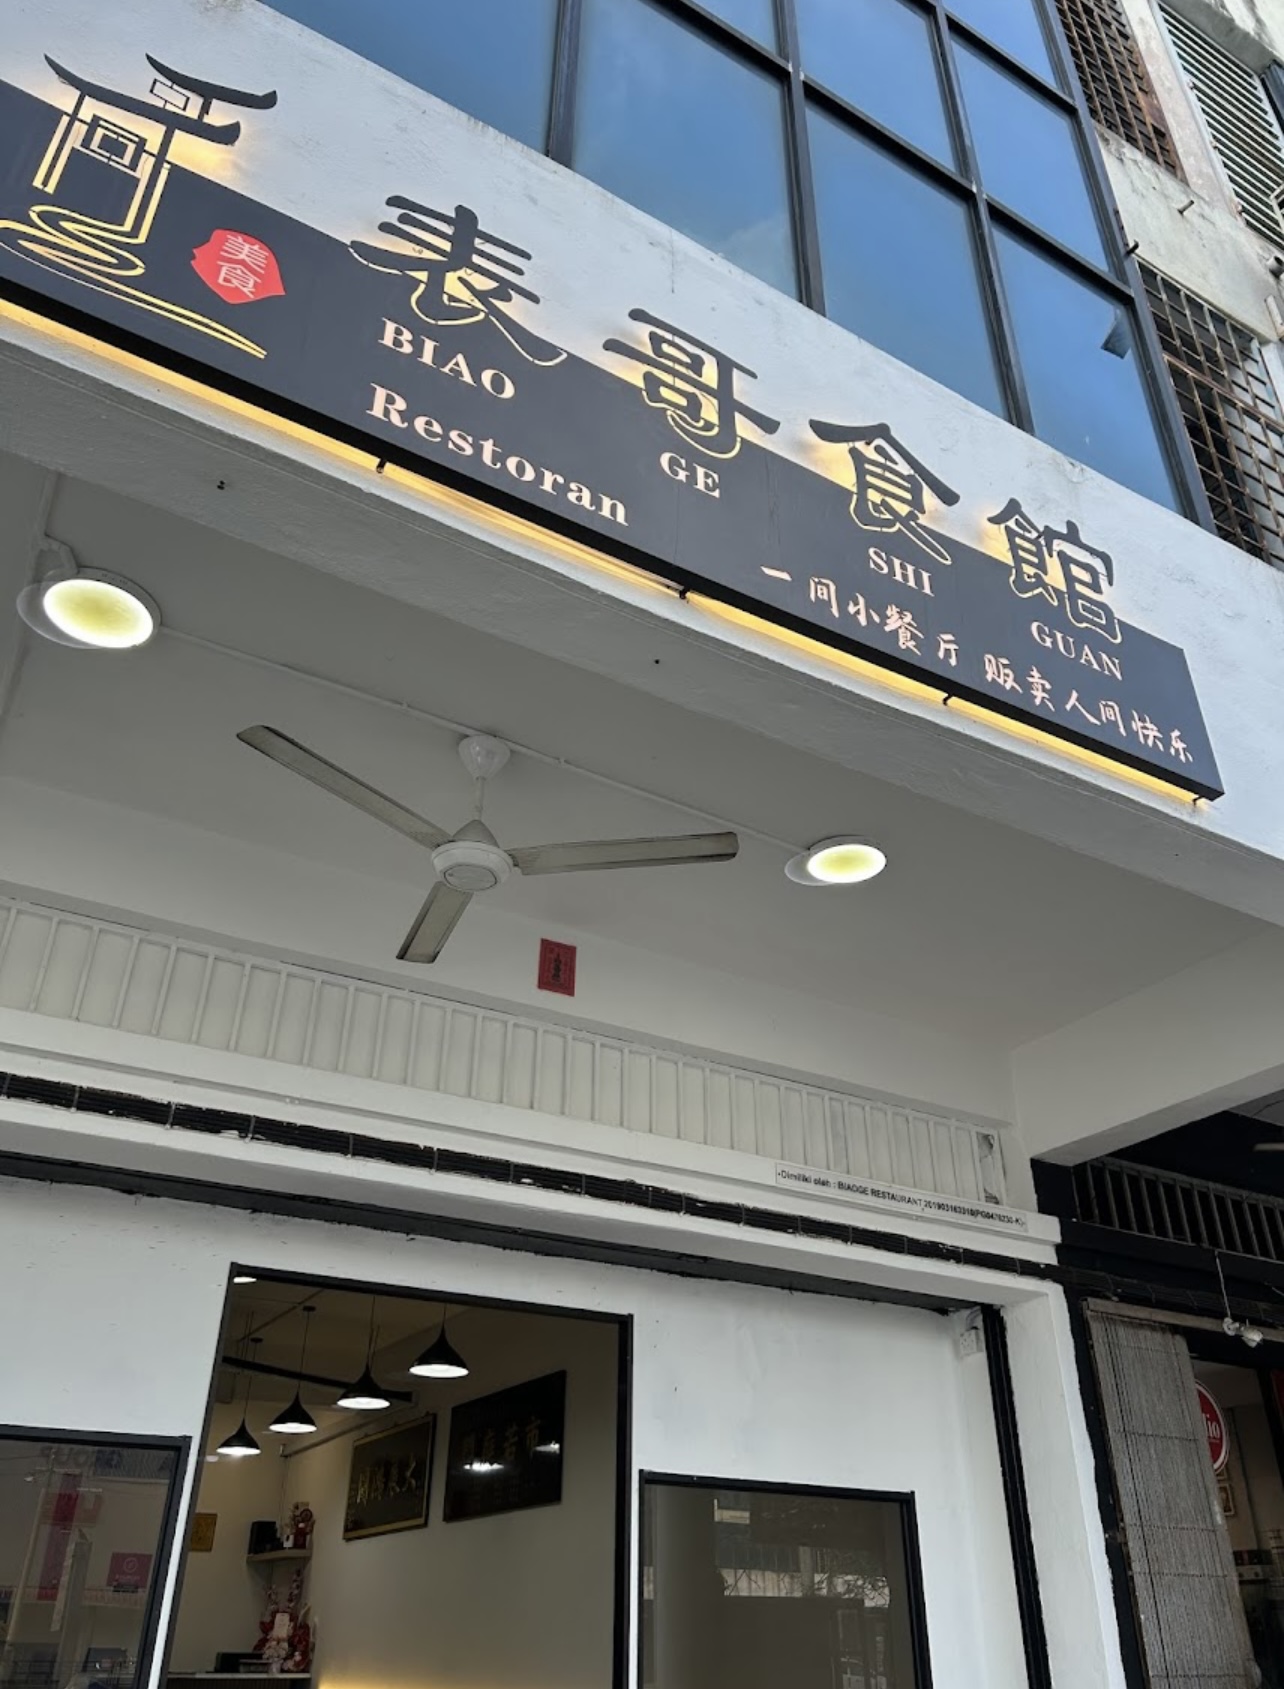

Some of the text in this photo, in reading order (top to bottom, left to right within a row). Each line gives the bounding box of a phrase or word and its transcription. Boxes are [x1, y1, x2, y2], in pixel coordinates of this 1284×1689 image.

[216, 234, 269, 299] 美食
[366, 383, 629, 527] Restoran
[378, 318, 1123, 681] BIAO GE SHI GUAN
[760, 566, 1194, 763] 一间小餐厅 贩卖人间快乐
